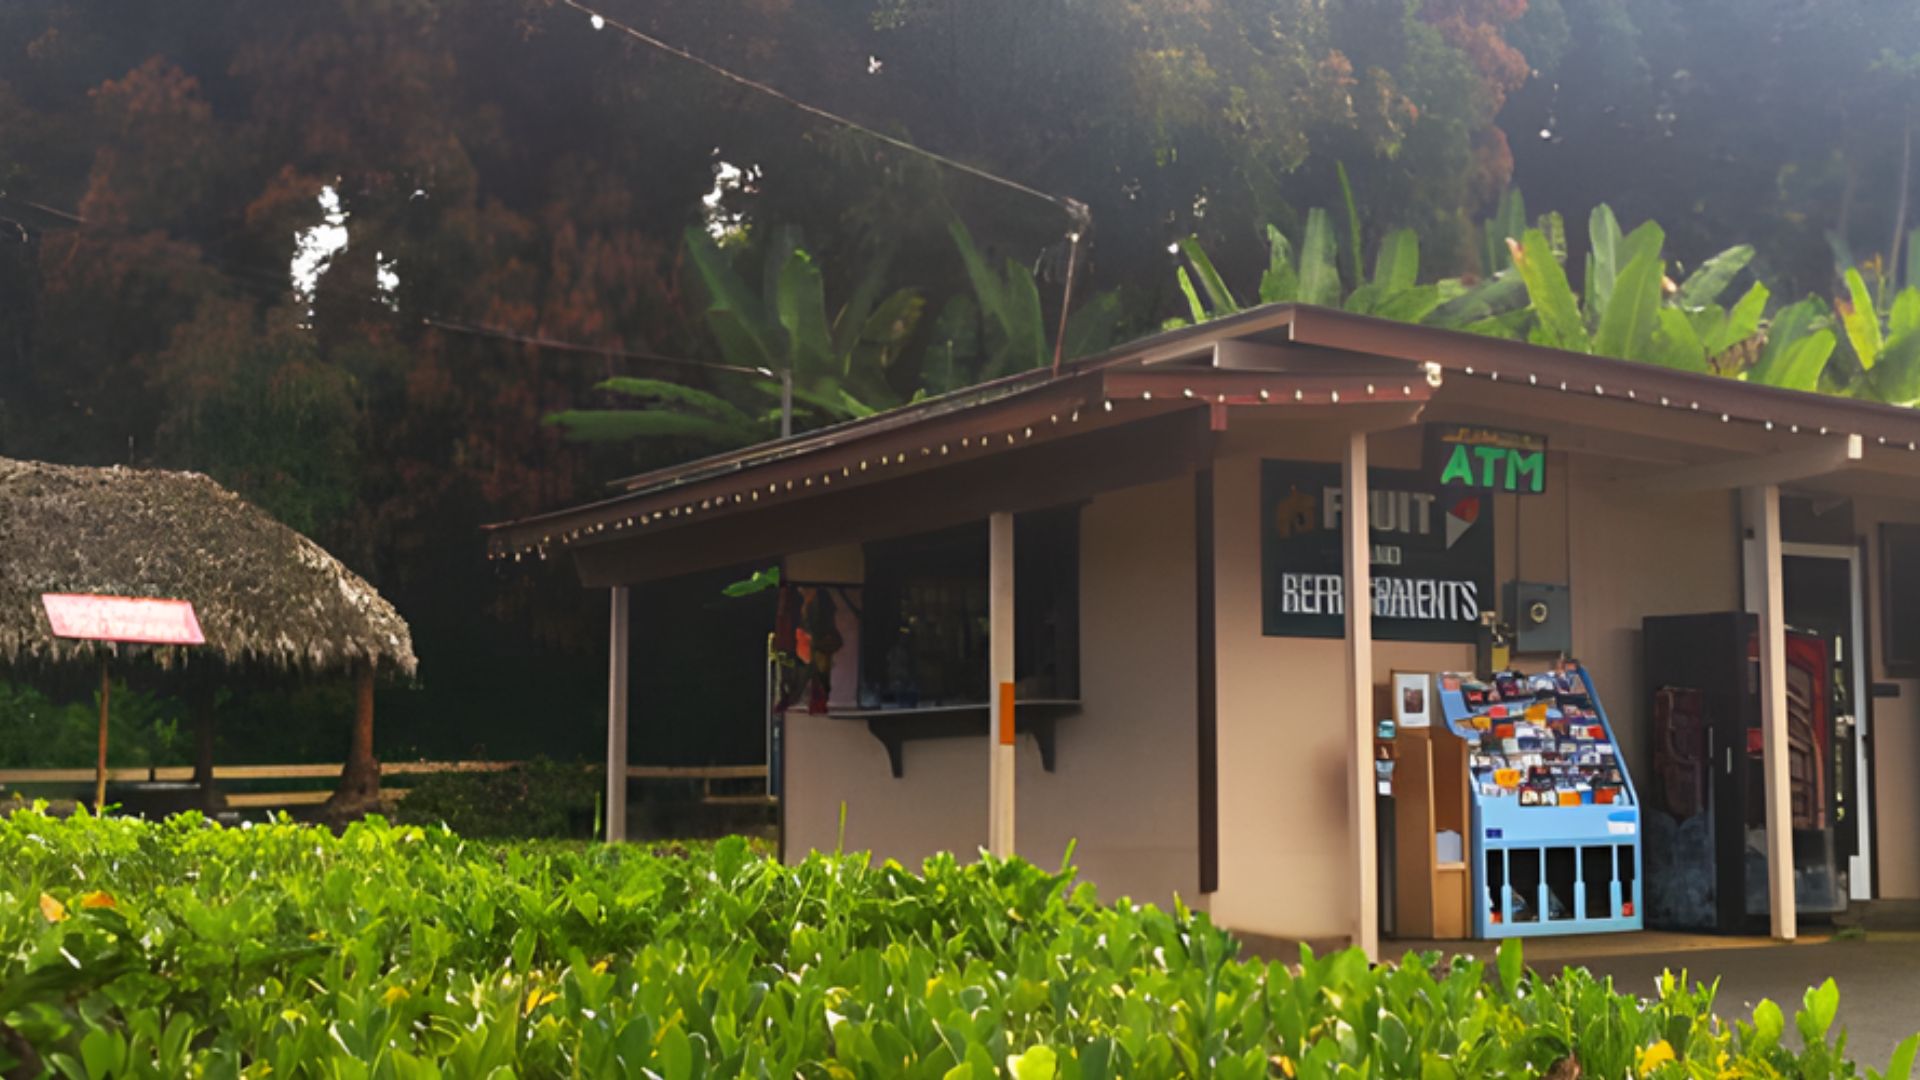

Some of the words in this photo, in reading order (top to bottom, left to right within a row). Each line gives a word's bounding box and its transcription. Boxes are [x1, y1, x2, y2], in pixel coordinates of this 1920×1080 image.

[1440, 444, 1544, 493] ATM
[1322, 486, 1436, 534] FUIT
[1281, 572, 1478, 621] REFRMENTS
